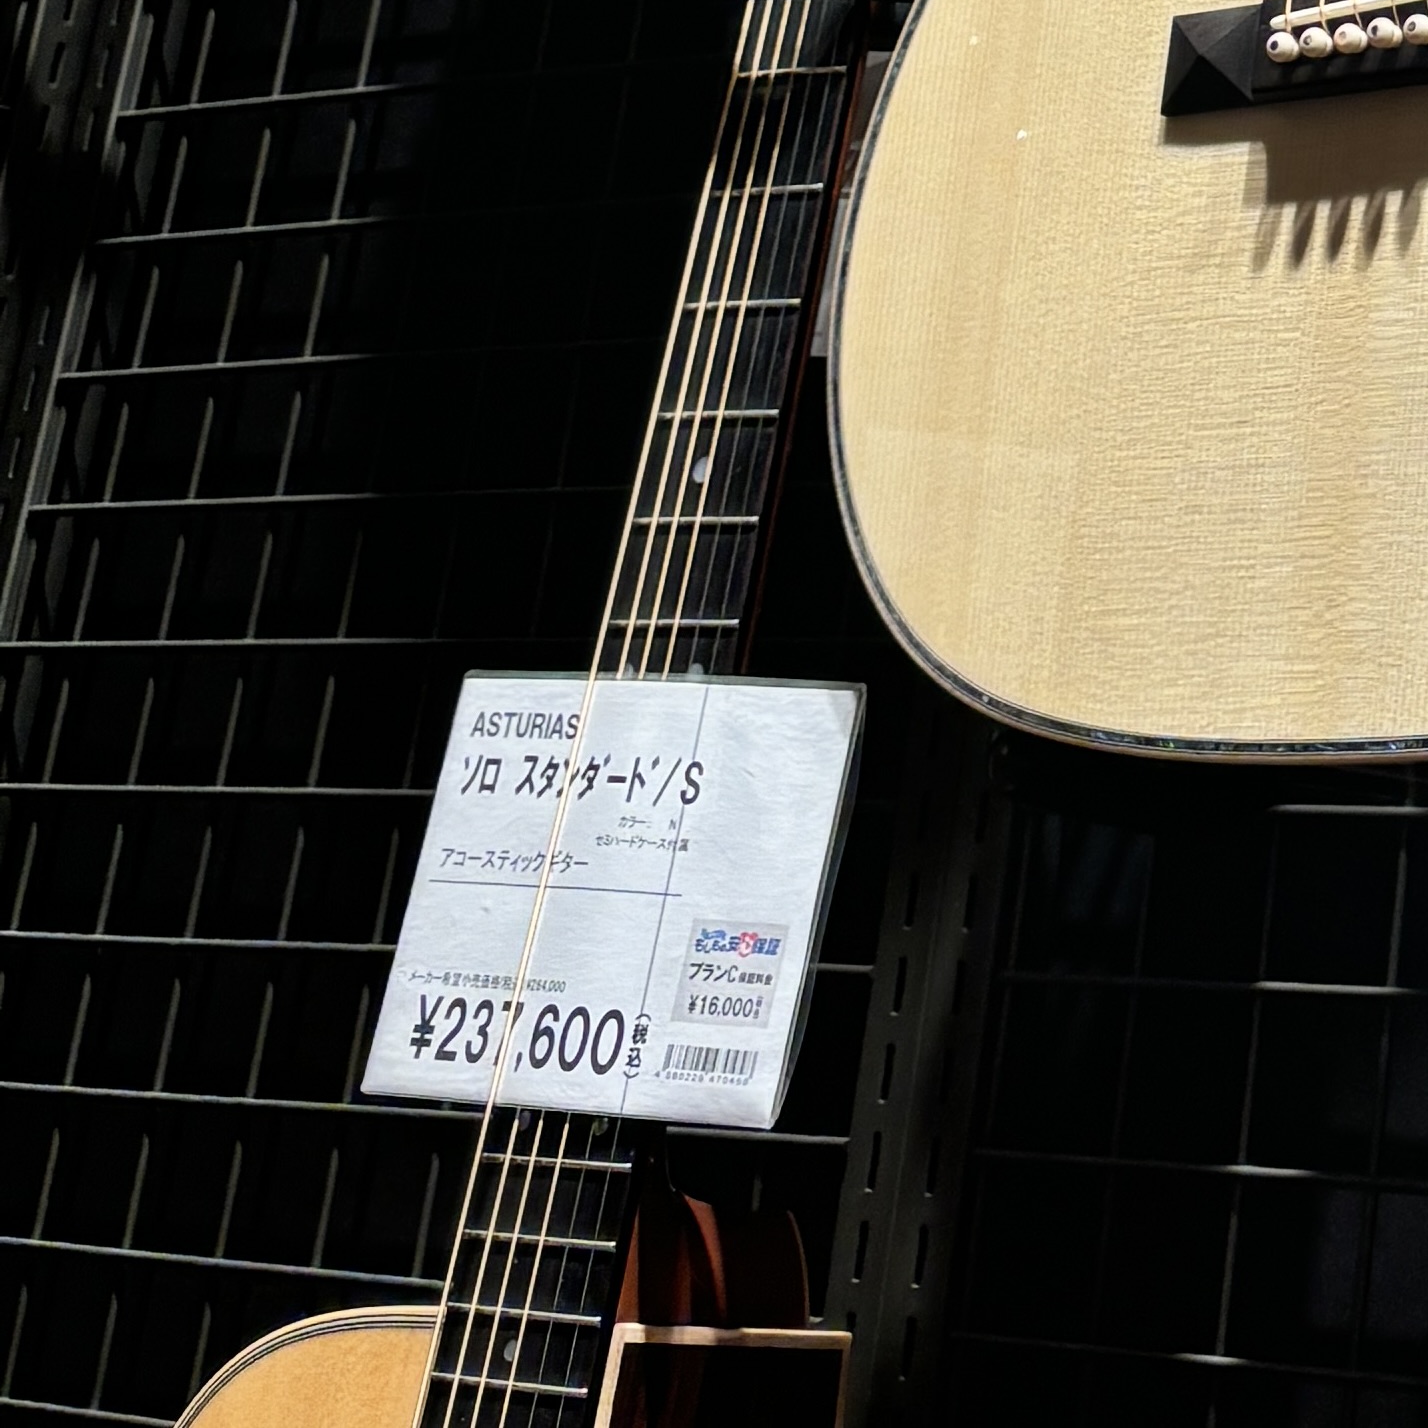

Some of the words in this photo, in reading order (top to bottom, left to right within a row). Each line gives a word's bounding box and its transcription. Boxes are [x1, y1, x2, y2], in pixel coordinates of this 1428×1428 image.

[470, 711, 580, 740] ASTURIAS
[461, 754, 502, 795] ソロ
[689, 962, 738, 983] プランC
[688, 994, 754, 1018] ¥16,000
[409, 994, 625, 1075] ¥237,600
